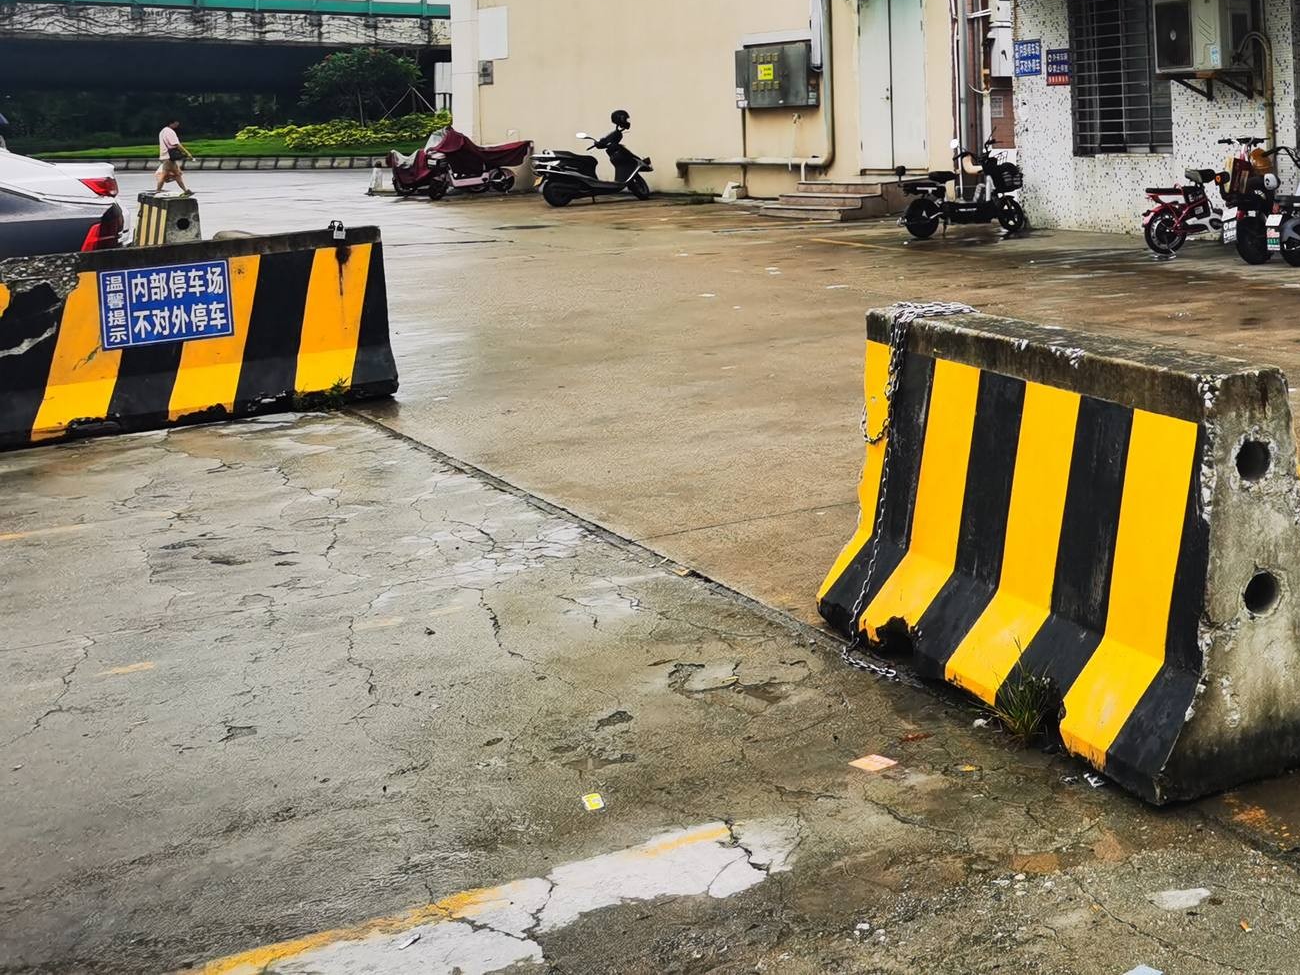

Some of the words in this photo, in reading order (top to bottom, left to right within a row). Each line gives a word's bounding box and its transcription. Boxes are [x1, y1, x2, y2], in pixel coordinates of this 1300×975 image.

[131, 266, 224, 303] 内部停车场
[105, 275, 128, 343] 温馨提示
[133, 301, 227, 338] 不对外停车
